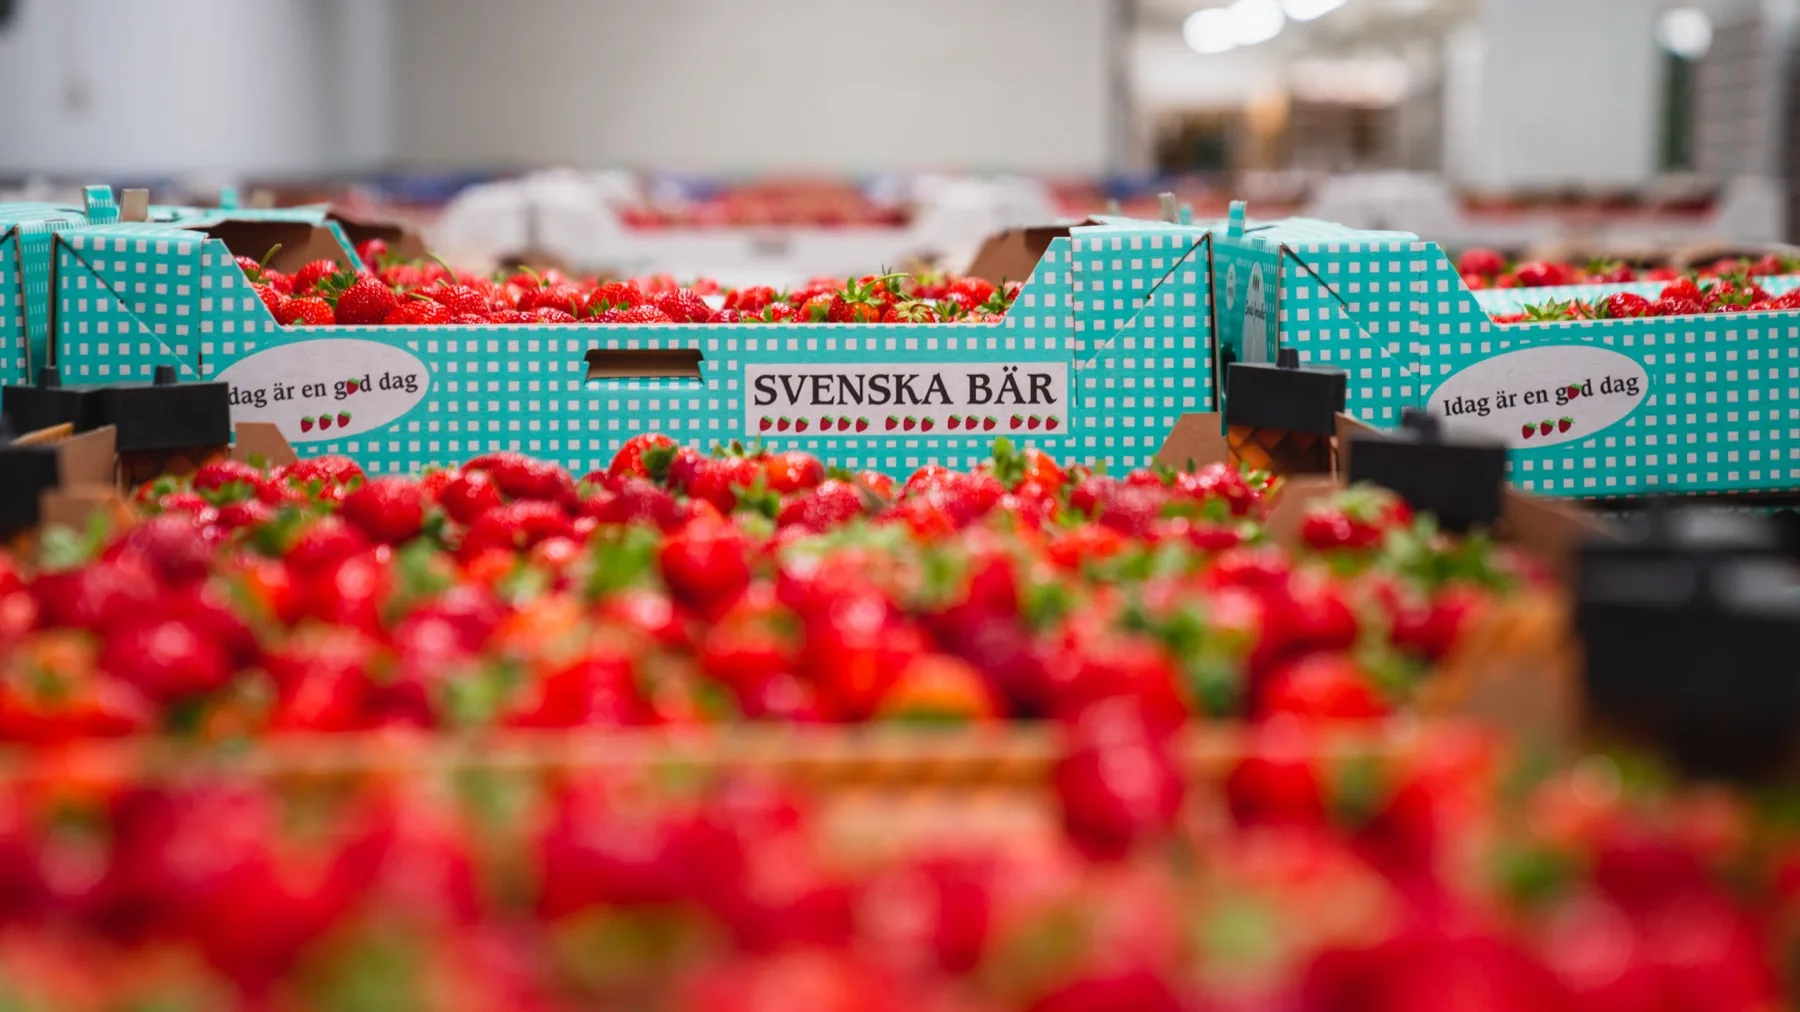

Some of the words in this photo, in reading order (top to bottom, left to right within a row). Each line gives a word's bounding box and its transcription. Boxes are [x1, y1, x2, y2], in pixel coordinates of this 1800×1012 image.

[228, 386, 268, 408] dag
[273, 382, 295, 401] är
[302, 382, 327, 399] en
[379, 371, 418, 393] dag
[754, 372, 954, 406] SVENSKA
[966, 365, 1058, 405] BÄR
[1443, 395, 1491, 417] Idag
[1496, 390, 1517, 409] är
[1523, 388, 1549, 405] en
[1600, 375, 1640, 397] dag
